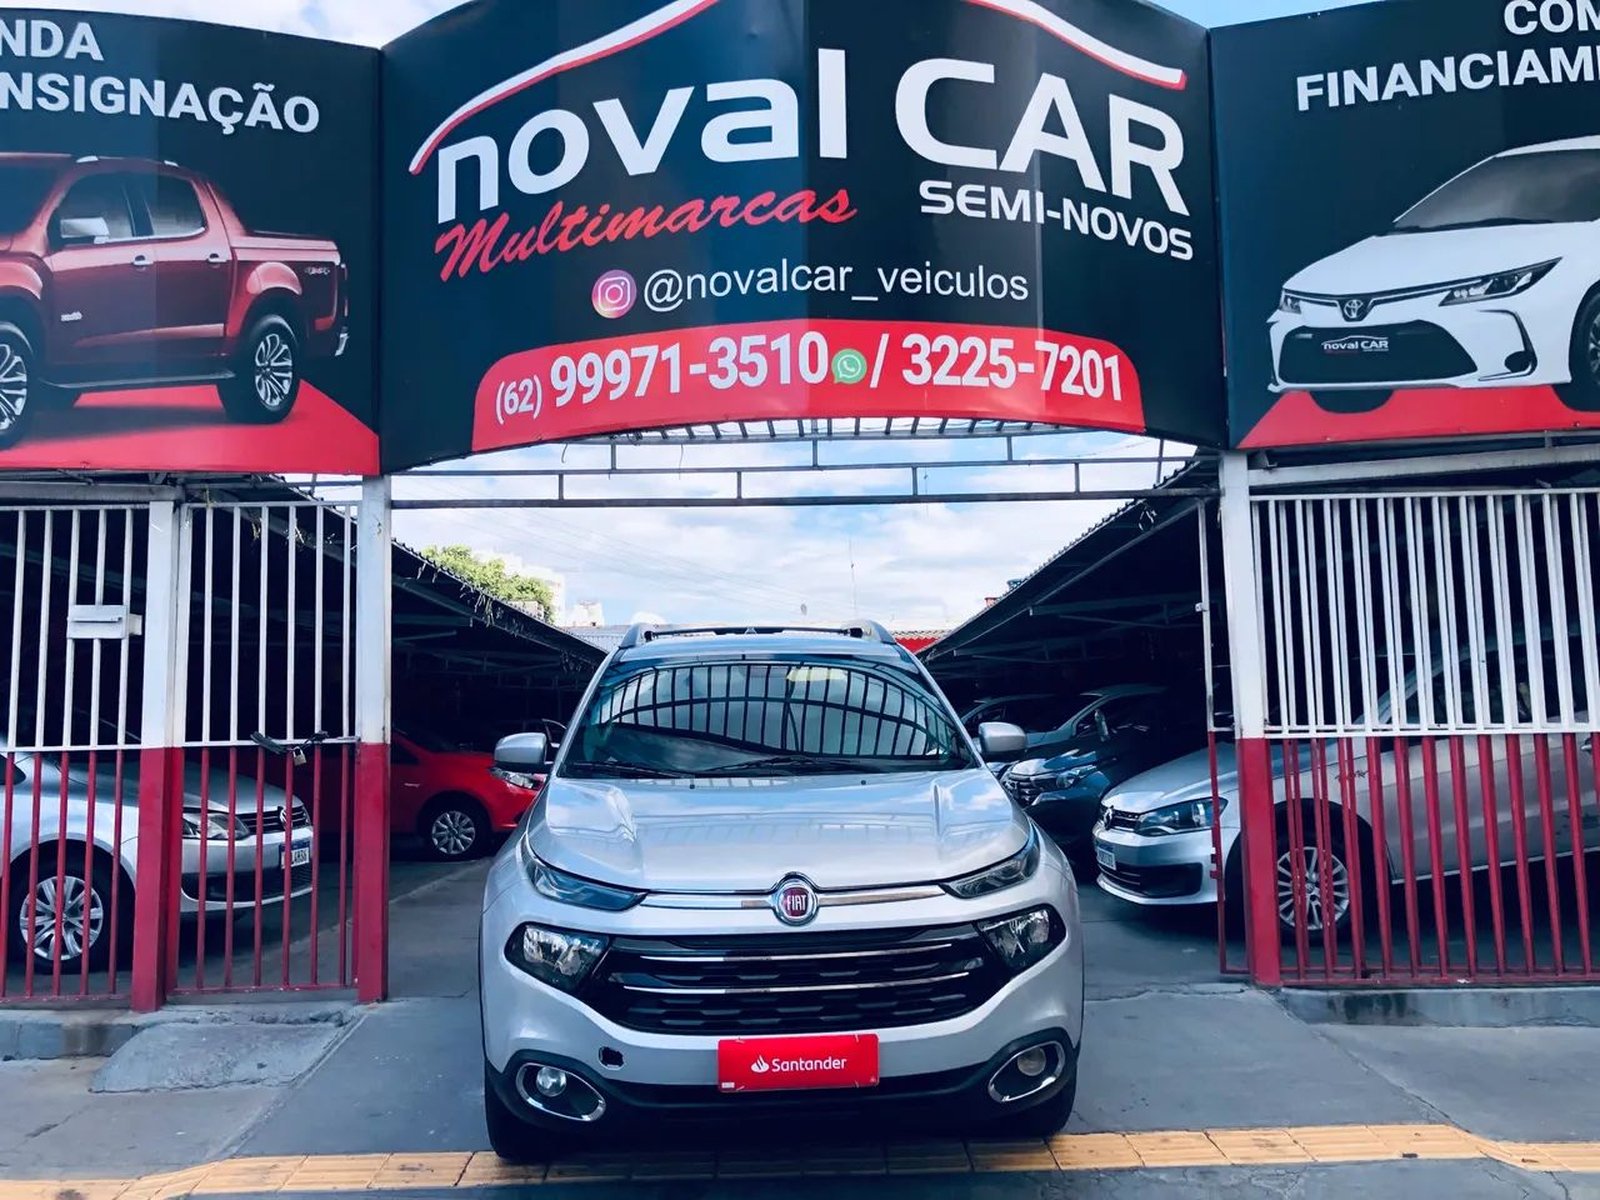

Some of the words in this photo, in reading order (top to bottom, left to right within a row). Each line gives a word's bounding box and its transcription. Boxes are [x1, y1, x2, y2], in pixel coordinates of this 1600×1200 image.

[0, 71, 319, 135] NSIGNAÇÃO
[1296, 45, 1600, 111] FINANCIAM
[438, 47, 848, 225] noval
[895, 57, 1190, 216] CAR
[434, 188, 858, 282] Multimarcas
[919, 179, 1194, 261] SEMI-NOVOS
[643, 258, 1029, 313] @novalcar_veiculos
[1323, 341, 1359, 350] noval
[1360, 340, 1389, 349] CAR
[495, 374, 543, 425] (62)
[550, 331, 829, 407] 99971-3510
[901, 333, 1122, 402] 3225-7201
[786, 894, 807, 911] FIAT
[771, 1056, 847, 1073] Santander
